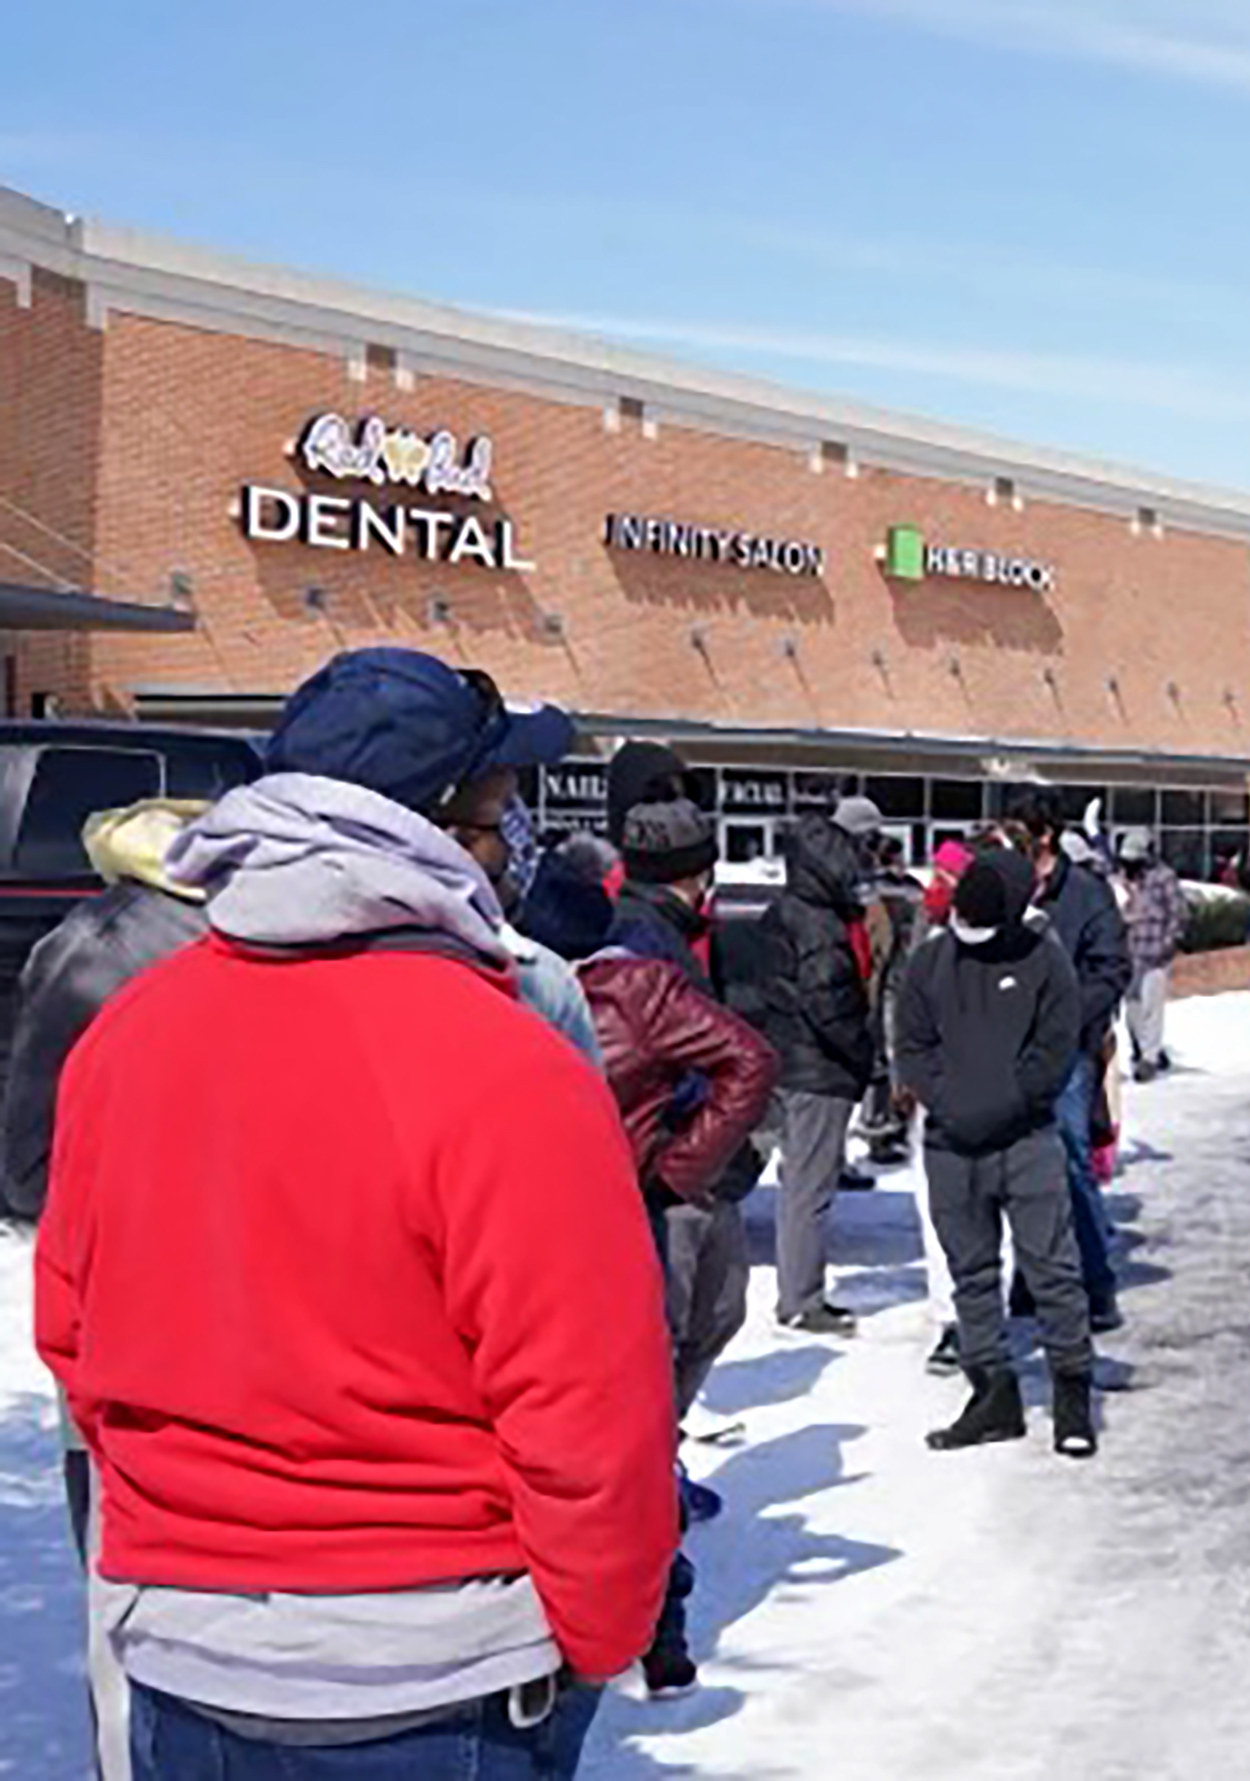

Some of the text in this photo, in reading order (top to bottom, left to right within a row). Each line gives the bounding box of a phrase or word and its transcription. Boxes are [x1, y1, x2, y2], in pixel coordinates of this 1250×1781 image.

[246, 485, 537, 572] DENTAL
[605, 513, 826, 578] INFINITY SALON
[980, 551, 1058, 591] BLOCK
